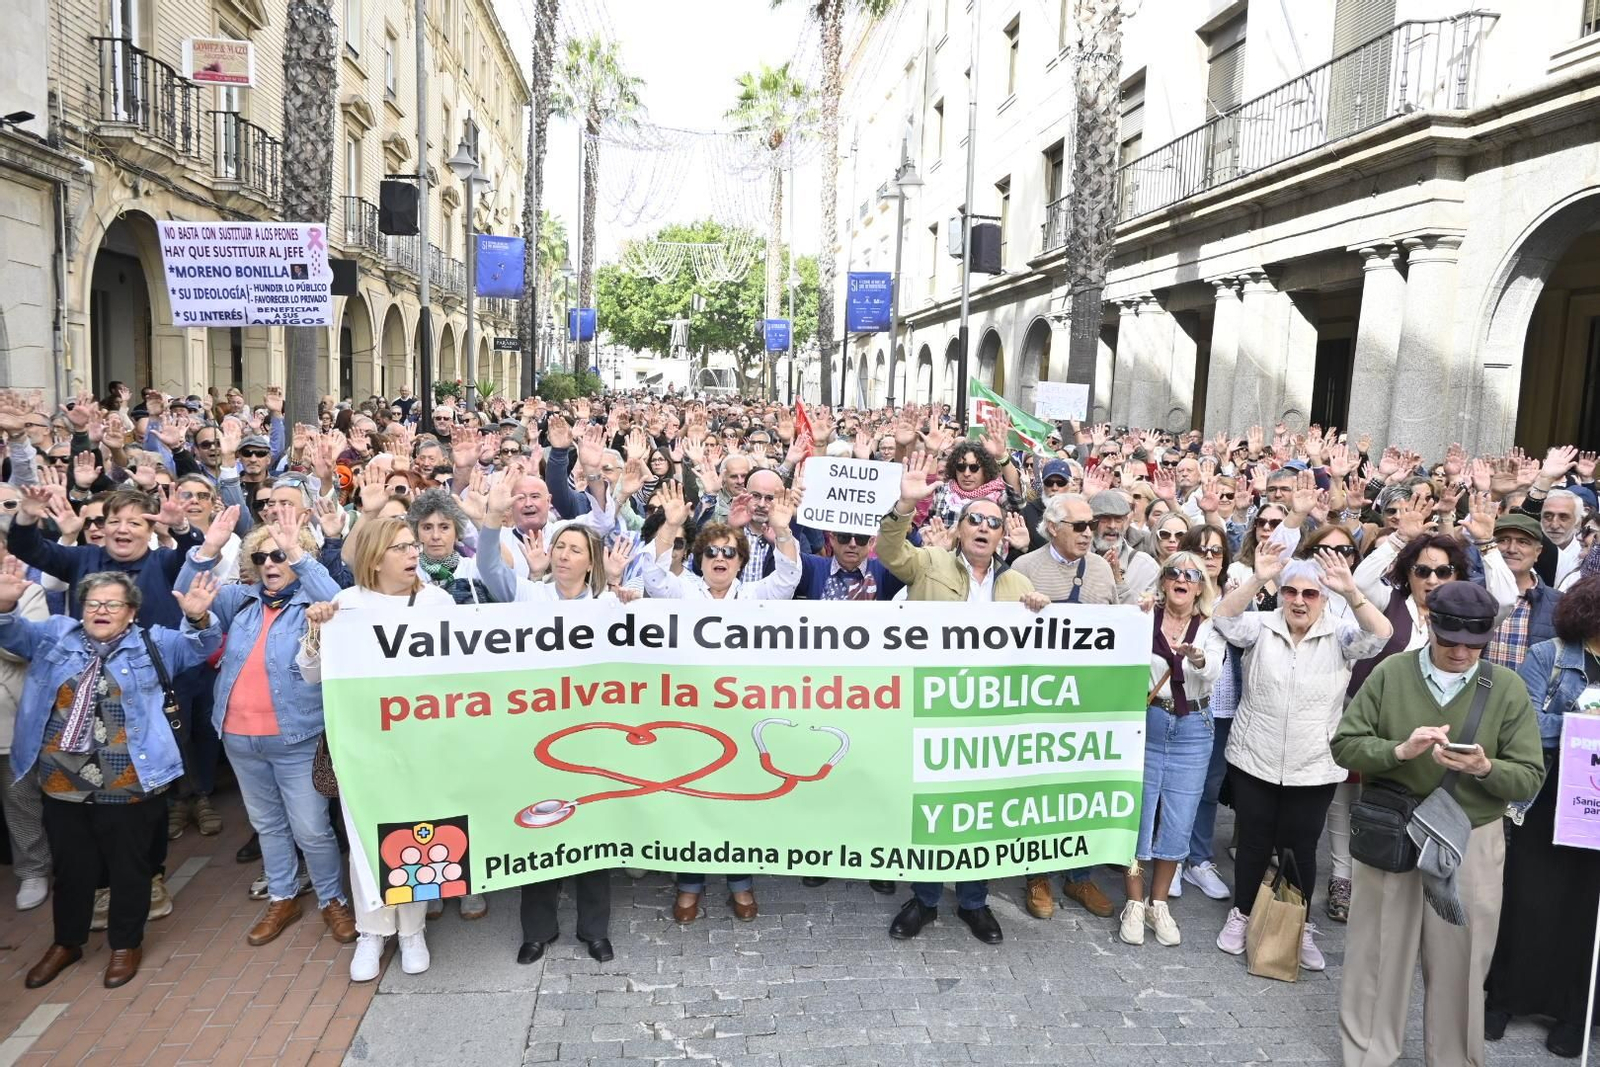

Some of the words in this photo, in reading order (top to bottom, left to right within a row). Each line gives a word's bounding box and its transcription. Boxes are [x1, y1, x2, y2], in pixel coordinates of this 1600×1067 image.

[164, 226, 175, 240] NO
[178, 226, 199, 240] BASTA
[201, 226, 217, 240] CON
[219, 227, 253, 240] SUSTITUIR
[255, 228, 260, 240] A
[261, 228, 272, 240] LOS
[274, 228, 299, 241] PEONES
[164, 245, 185, 257] HAY
[188, 245, 210, 260] QUE
[213, 245, 267, 258] SUSTITUIR
[269, 246, 282, 258] AL
[283, 246, 304, 260] JEFE
[235, 265, 290, 278] BONILLA
[178, 287, 191, 300] SU
[193, 284, 247, 300] IDEOLOGÍA
[253, 283, 283, 292] HUNDIR
[285, 284, 294, 292] LO
[296, 281, 327, 292] PÚBLICO
[254, 295, 290, 304] FAVORECER
[291, 295, 299, 303] LO
[300, 294, 327, 303] PRIVADO
[183, 310, 197, 321] SU
[199, 308, 243, 320] INTERÉS
[251, 317, 325, 325] AMIGOS
[829, 464, 879, 481] SALUD
[826, 487, 876, 504] ANTES
[803, 507, 835, 522] QUE
[839, 511, 883, 527] DINER
[373, 615, 594, 659] Valverde
[606, 613, 677, 649] del
[693, 615, 870, 650] Camino
[883, 624, 929, 650] se
[942, 617, 1115, 650] moviliza
[923, 668, 1080, 709] PÚBLICA
[380, 691, 491, 731] para
[507, 676, 647, 715] salvar
[661, 673, 698, 707] la
[713, 675, 900, 710] Sanidad
[923, 730, 1122, 771] UNIVERSAL
[920, 804, 944, 834] Y
[952, 801, 994, 833] DE
[1001, 790, 1135, 828] CALIDAD
[485, 842, 634, 879] Plataforma
[640, 840, 779, 864] ciudadana
[787, 848, 833, 870] por
[840, 844, 862, 867] la
[870, 846, 990, 871] SANIDAD
[996, 835, 1089, 866] PÚBLICA
